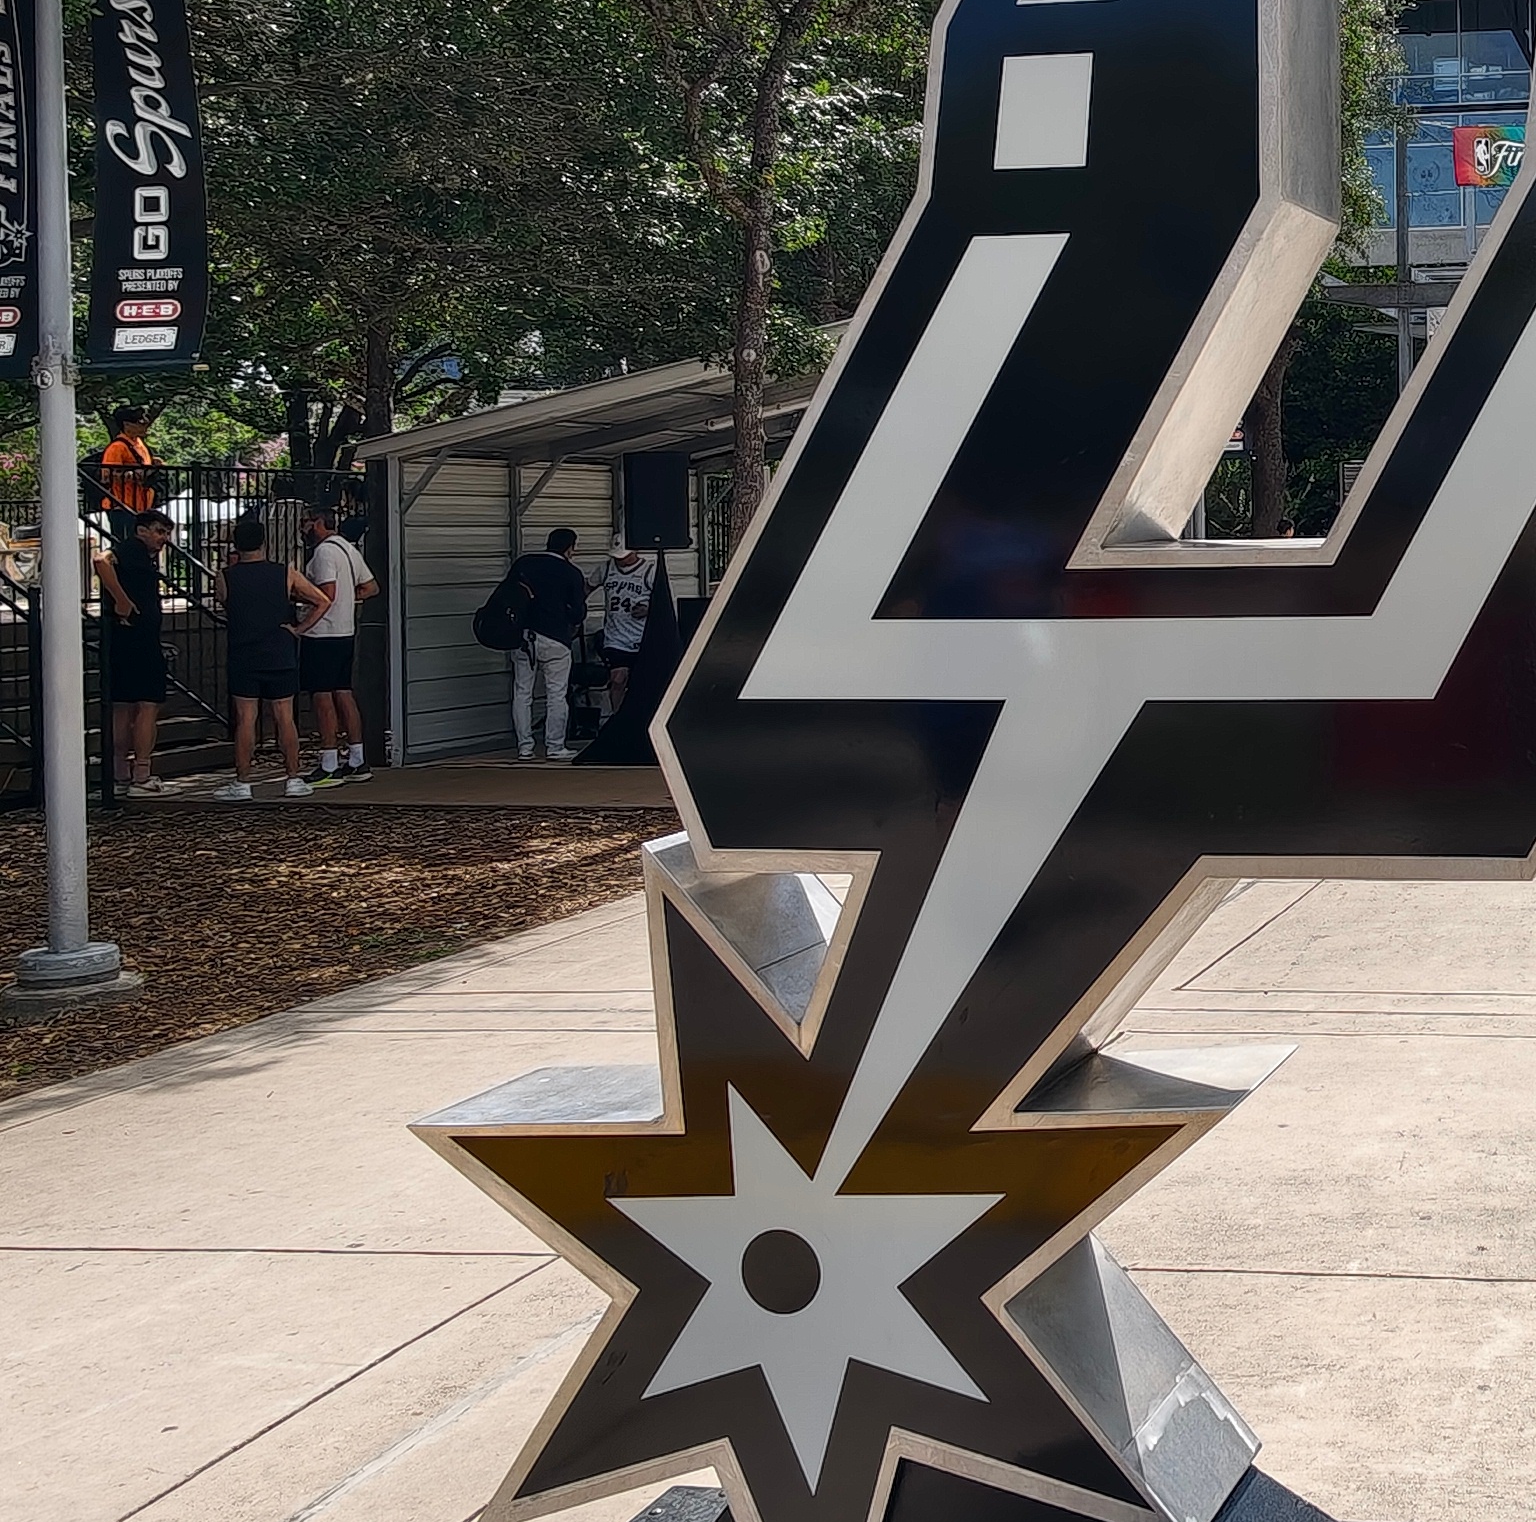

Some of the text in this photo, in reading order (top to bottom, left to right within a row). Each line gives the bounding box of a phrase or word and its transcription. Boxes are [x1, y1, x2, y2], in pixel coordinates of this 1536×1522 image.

[133, 186, 169, 260] GO
[124, 333, 168, 344] LEDGER
[610, 596, 632, 613] 24
